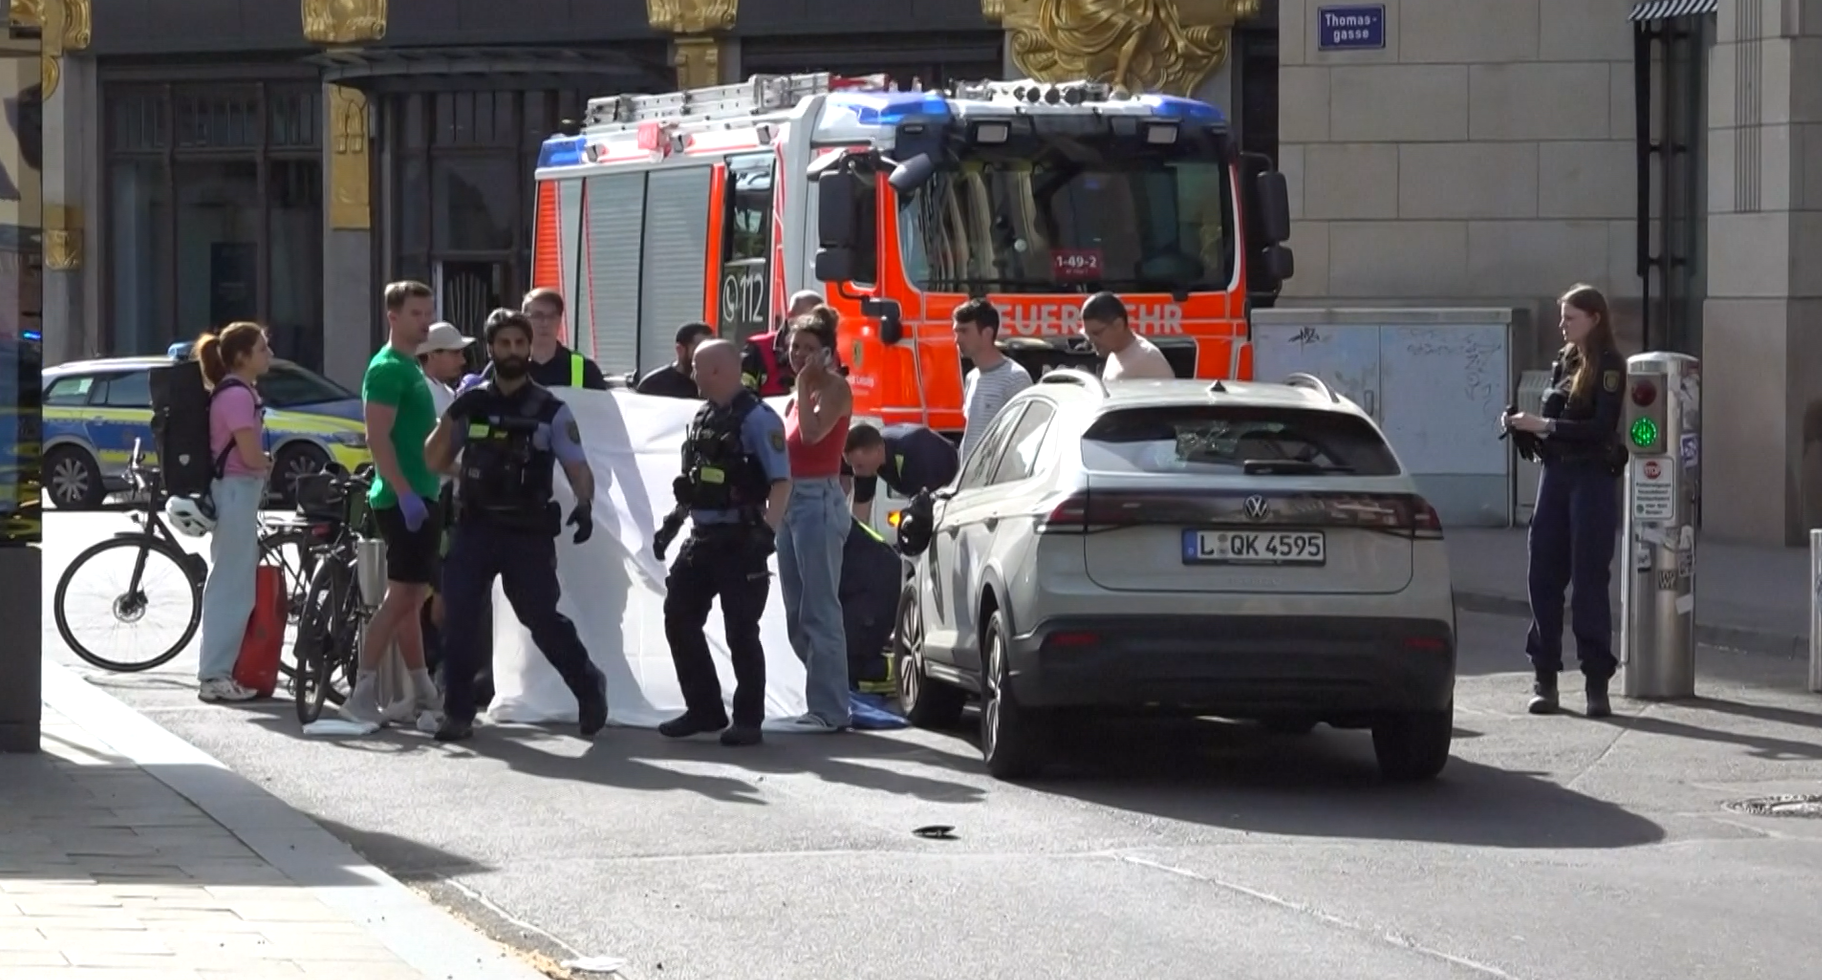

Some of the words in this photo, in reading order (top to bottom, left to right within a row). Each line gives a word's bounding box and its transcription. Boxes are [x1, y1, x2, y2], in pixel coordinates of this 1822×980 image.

[1324, 12, 1377, 27] Thomas-
[1333, 29, 1370, 43] gasse
[1056, 255, 1097, 268] 1-49-2
[740, 273, 764, 323] 112
[997, 303, 1183, 336] EUEREHR
[1200, 534, 1214, 556] L
[1230, 534, 1259, 556] QK
[1265, 534, 1321, 557] 4595
